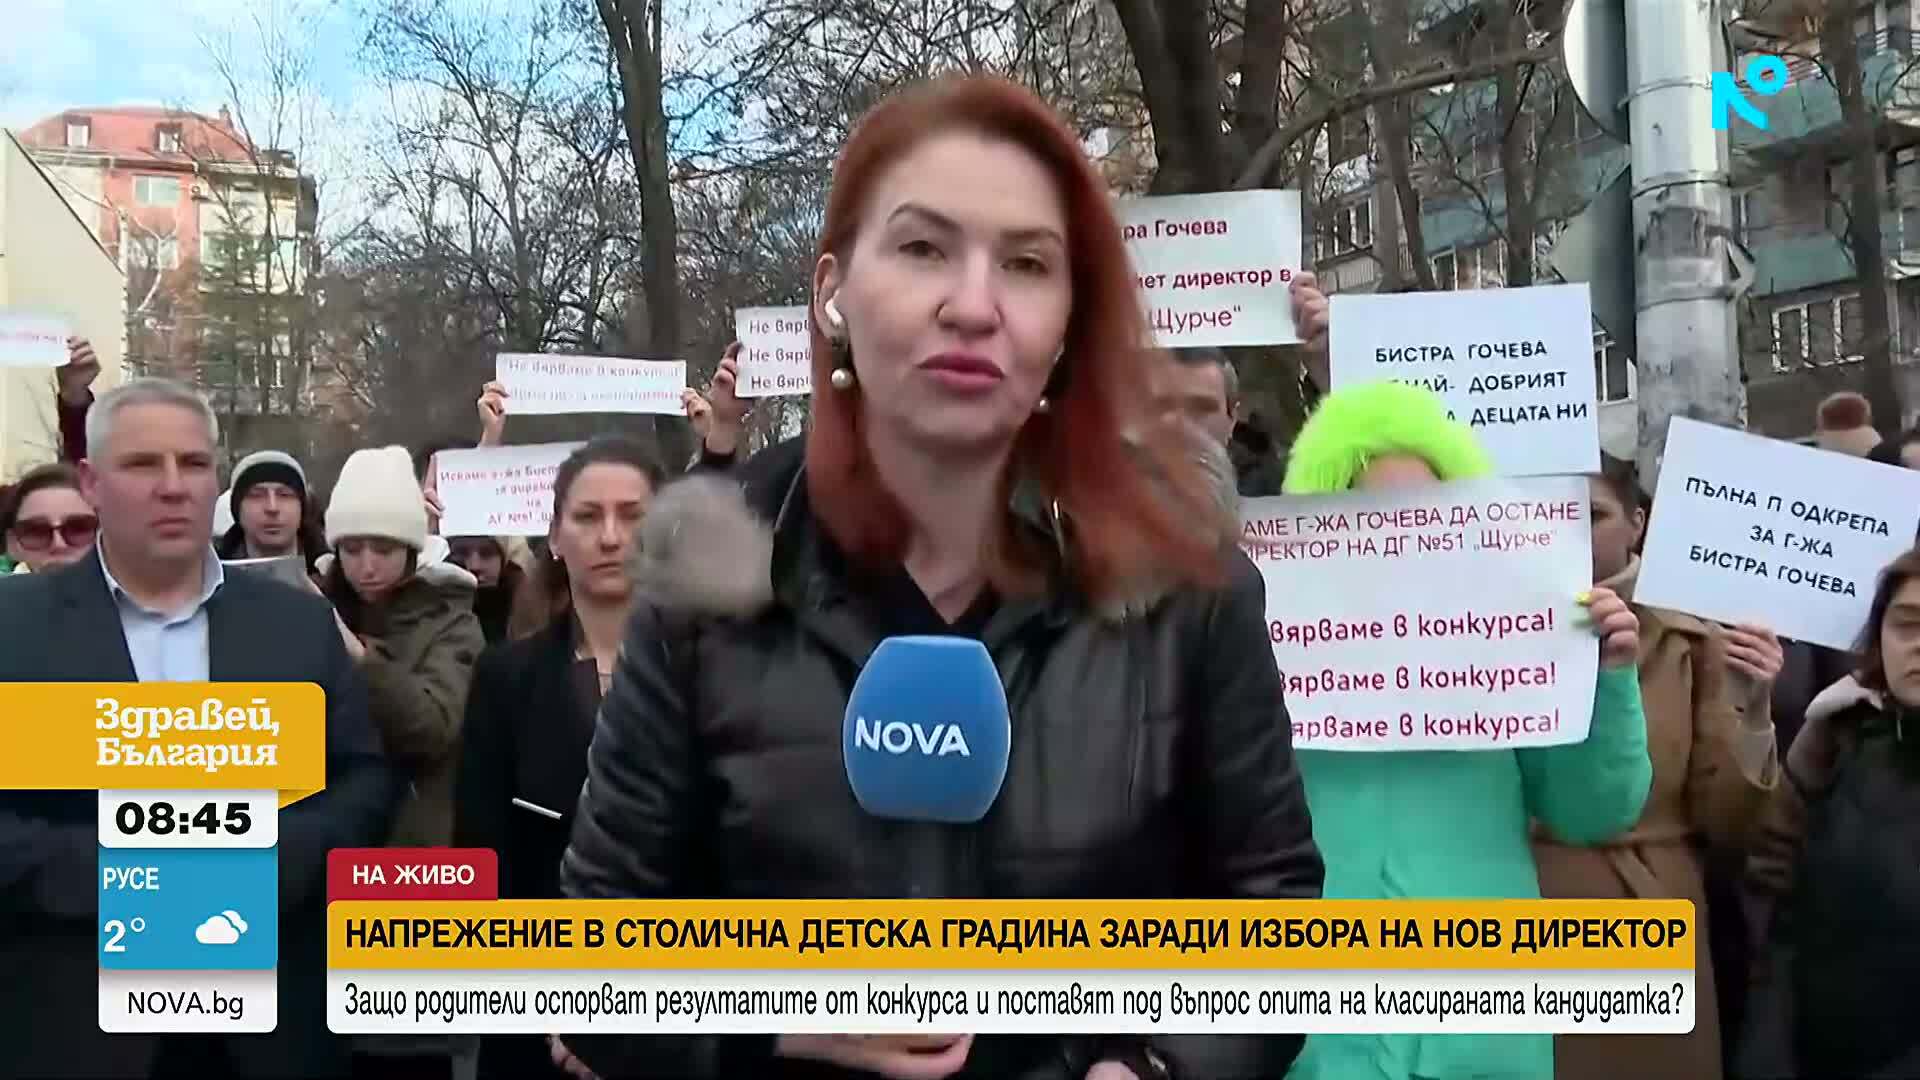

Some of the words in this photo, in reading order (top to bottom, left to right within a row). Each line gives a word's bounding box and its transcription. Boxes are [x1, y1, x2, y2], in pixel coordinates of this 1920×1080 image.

[1123, 224, 1148, 240] ра
[1155, 219, 1227, 238] Гочева
[1172, 269, 1272, 290] директор
[1280, 269, 1292, 283] в
[750, 319, 770, 334] Не
[749, 348, 770, 362] Не
[1375, 345, 1455, 363] БИСТРА
[1468, 340, 1548, 360] ГОЧЕВА
[751, 376, 772, 390] Не
[776, 374, 809, 390] вяр
[1468, 371, 1568, 394] ДОБРИЯТ
[1470, 405, 1551, 427] ДЕЦАТА
[1556, 403, 1588, 420] НИ
[1685, 476, 1758, 507] ПЪЛНА
[1243, 518, 1289, 537] АМЕ
[1296, 513, 1350, 535] Г-ЖА
[1356, 507, 1443, 531] ГОЧЕВА
[1449, 504, 1481, 527] ДА
[1486, 501, 1581, 523] ОСТАНЕ
[1347, 537, 1377, 557] НА
[1384, 534, 1411, 557] ДГ
[1417, 531, 1464, 552] №51
[1750, 525, 1775, 545] ЗА
[1784, 533, 1833, 558] Г-ЖА
[1689, 545, 1768, 577] БИСТРА
[1778, 565, 1856, 597] ГОЧЕВА
[1270, 618, 1384, 647] вярваме
[1393, 613, 1408, 638] в
[1418, 607, 1555, 640] конкурса!
[1395, 665, 1410, 691] в
[1420, 661, 1557, 693] конкурса!
[855, 716, 970, 757] NOVA
[1290, 714, 1389, 741] ярваме
[1399, 712, 1414, 737] в
[1424, 707, 1560, 741] конкурса!
